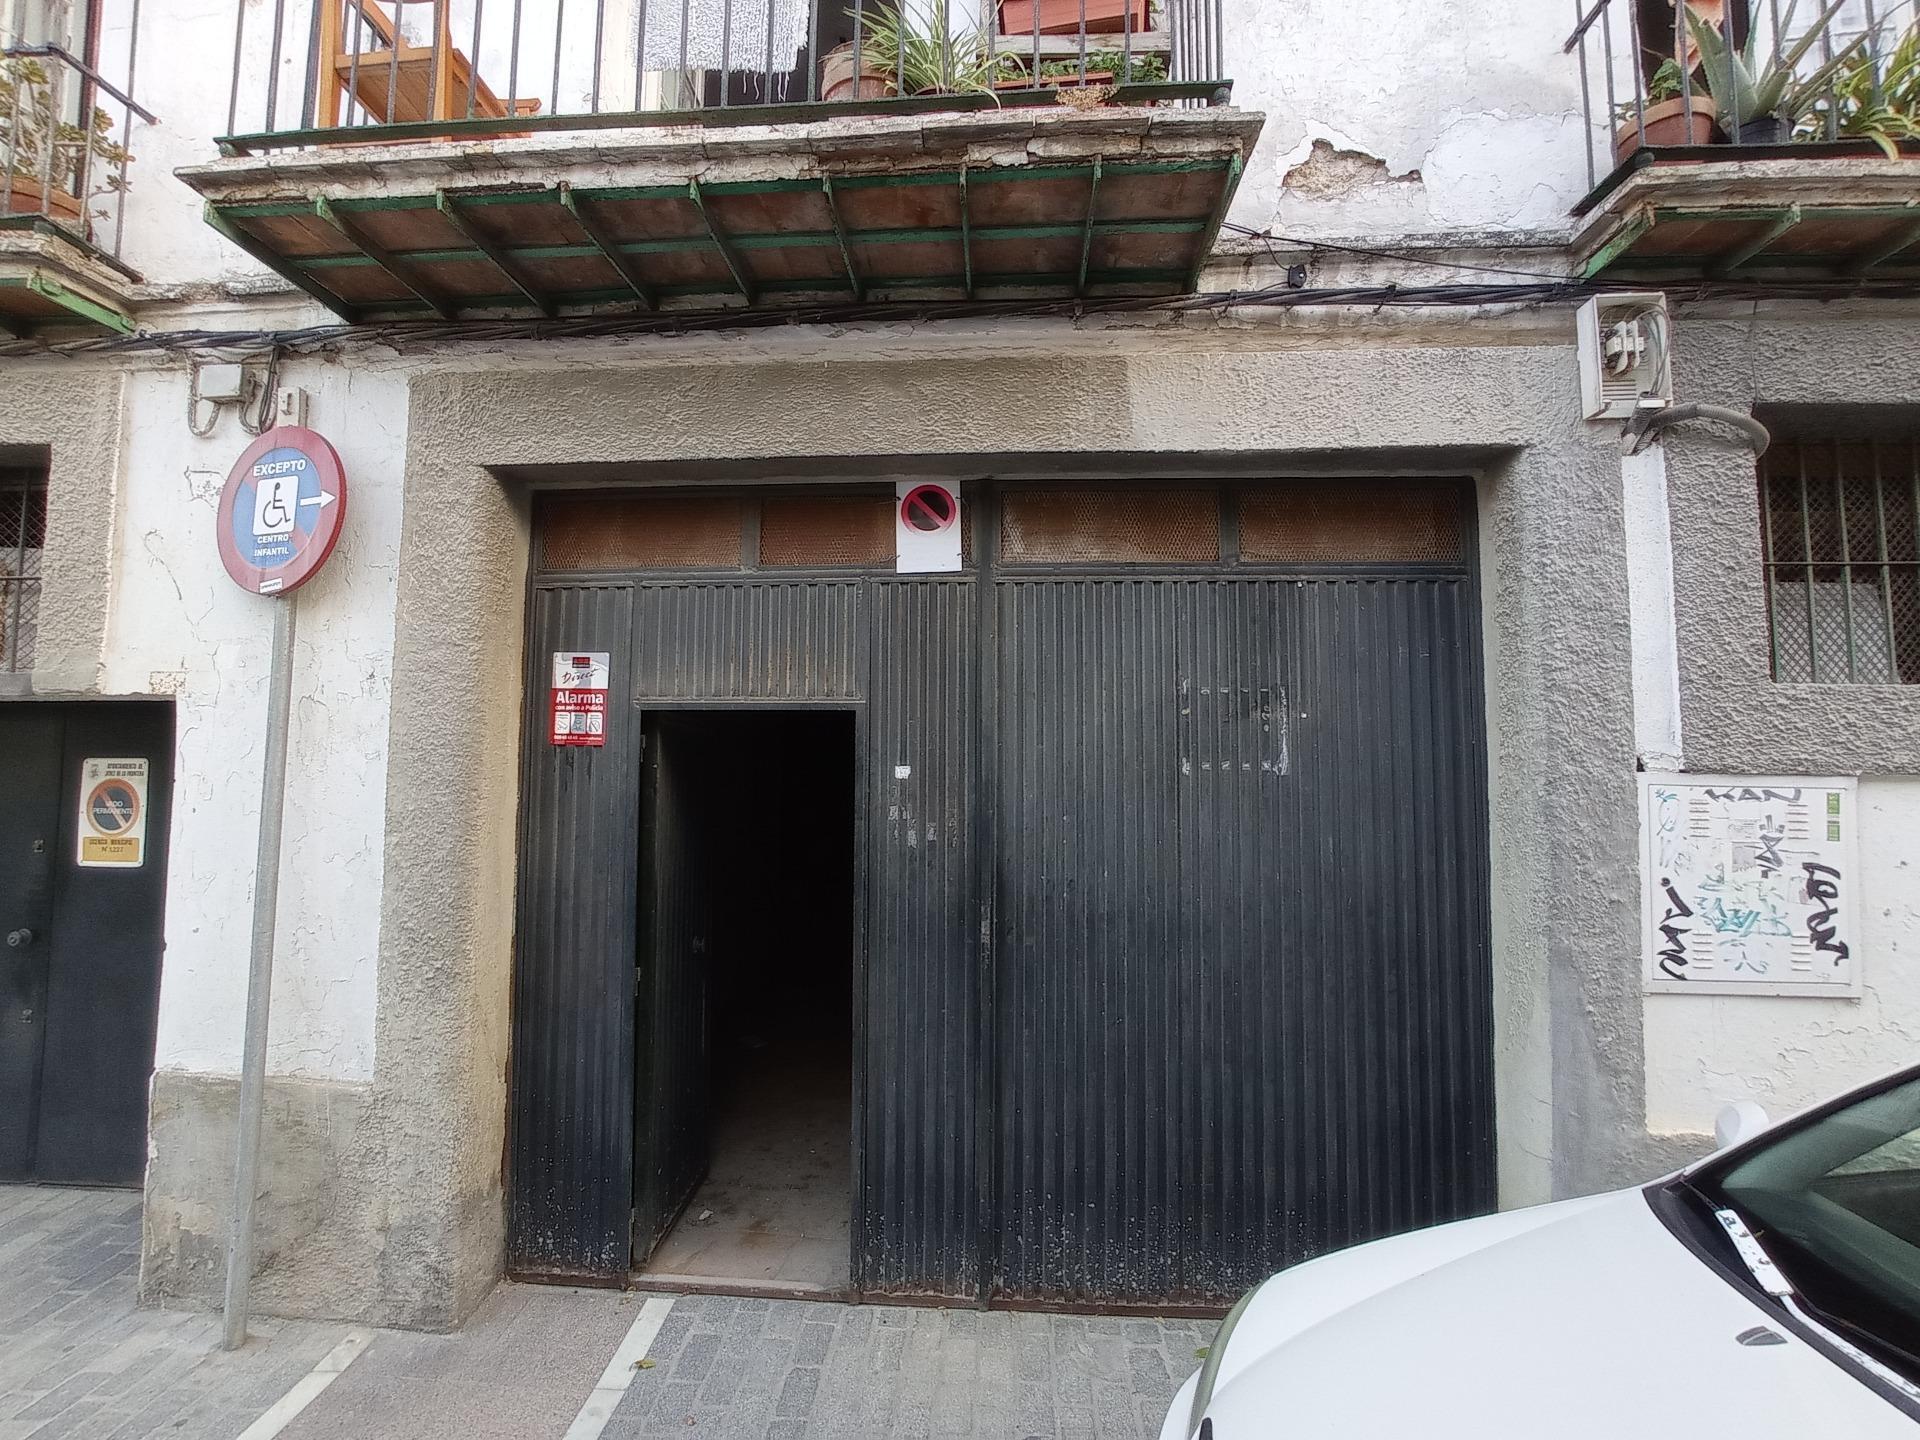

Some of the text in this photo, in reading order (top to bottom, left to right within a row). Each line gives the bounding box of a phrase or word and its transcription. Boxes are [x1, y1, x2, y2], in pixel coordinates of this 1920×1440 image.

[253, 459, 306, 477] EXCEPTO
[257, 534, 289, 544] CENTRO
[254, 546, 289, 557] INFANTIL
[556, 691, 604, 704] Alarma
